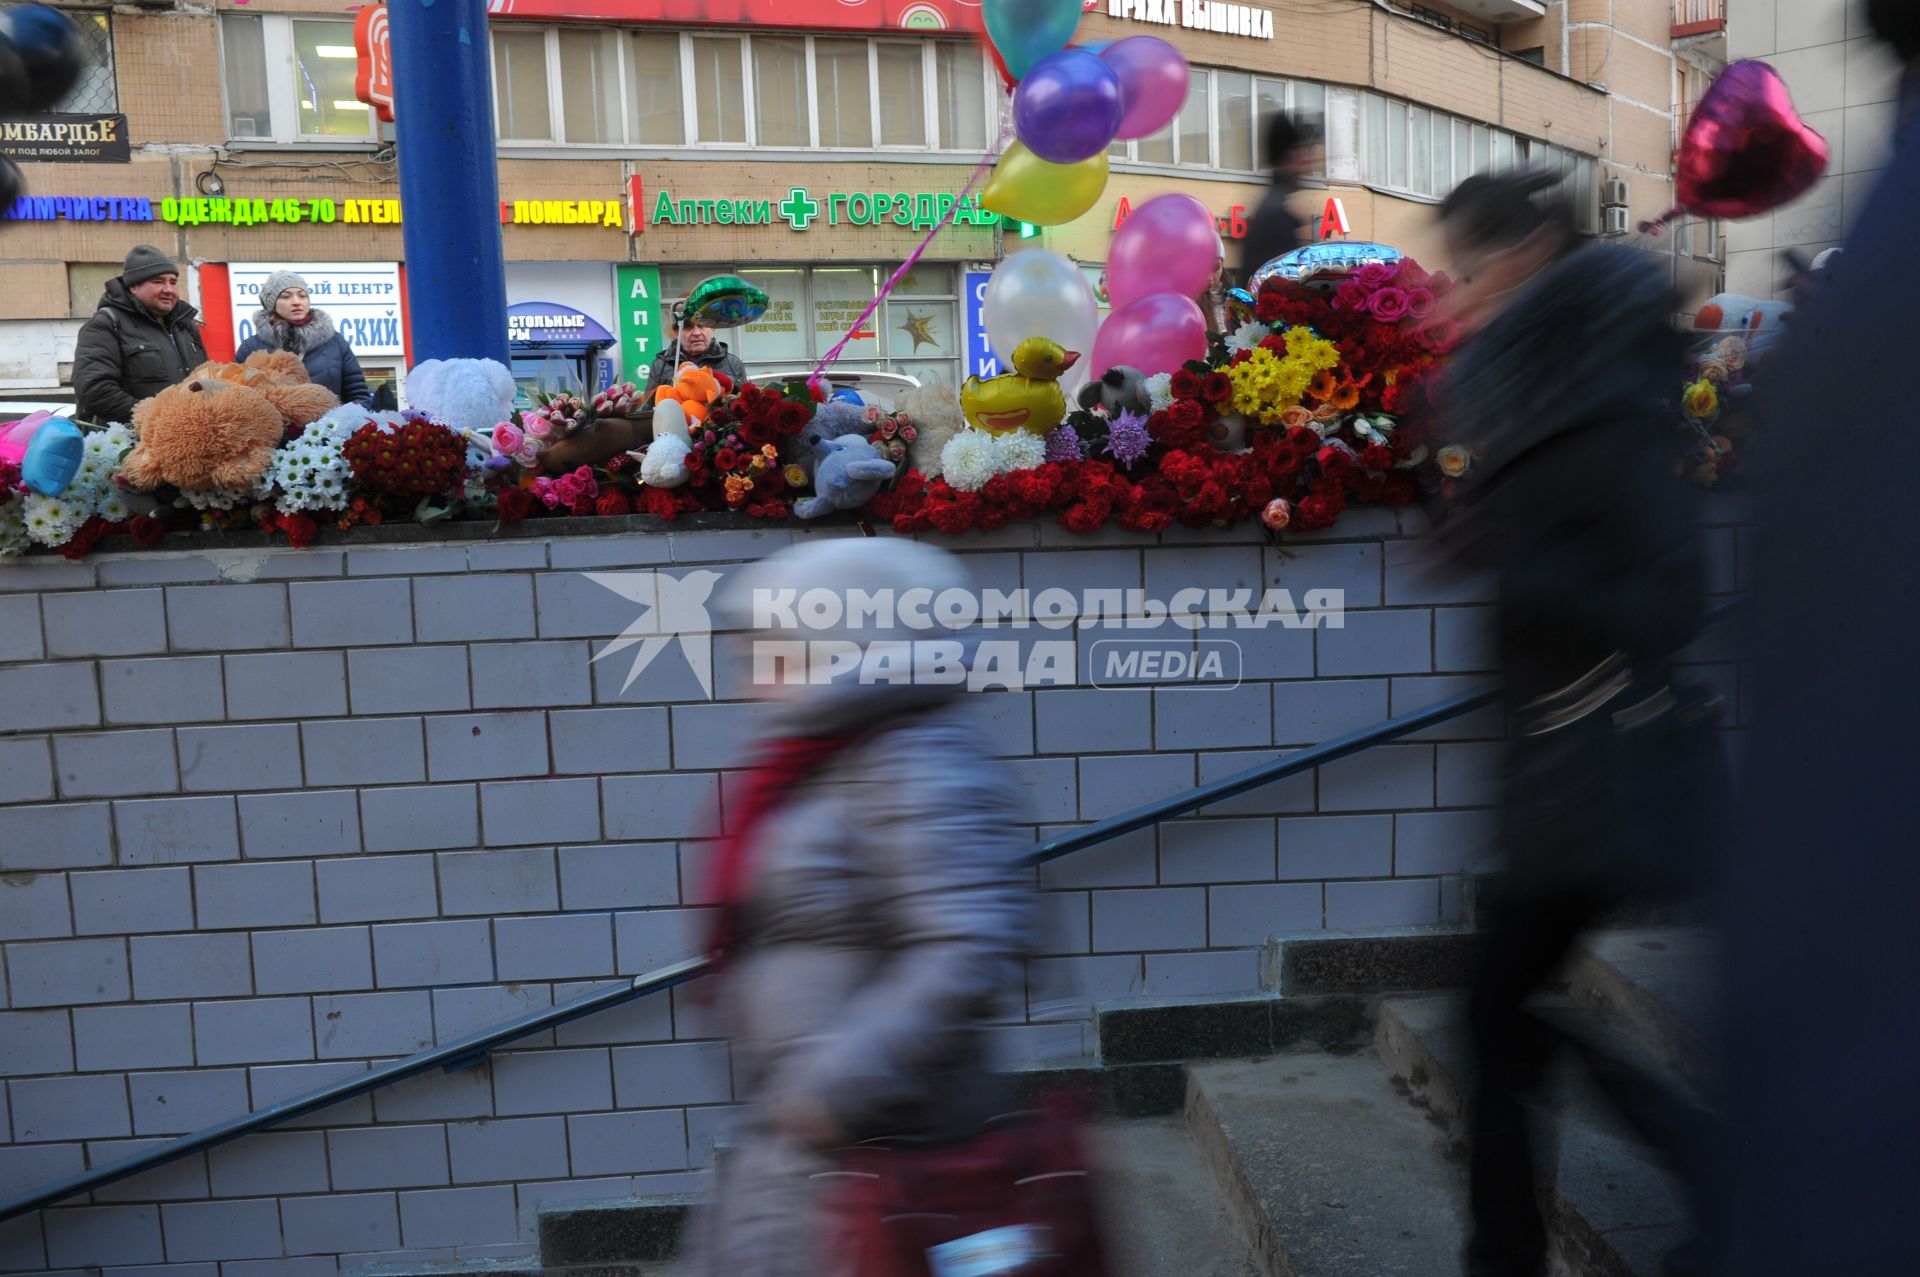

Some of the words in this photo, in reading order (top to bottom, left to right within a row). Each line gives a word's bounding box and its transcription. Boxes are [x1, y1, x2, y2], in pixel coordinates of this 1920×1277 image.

[1180, 0, 1274, 39] ВЫШИВКА
[0, 120, 116, 145] МБАРДЬЕ
[18, 148, 37, 156] ПОД
[40, 147, 71, 156] ЛЮБОЙ
[73, 148, 100, 156] ЗАЛОГ
[161, 197, 269, 226] ОДЕЖДА
[270, 198, 336, 224] 46-70
[344, 199, 403, 224] АТЕЛ
[513, 200, 623, 227] ЛОМБАРД
[652, 191, 771, 225] Аптеки
[828, 192, 999, 231] ГОРЗДРАВ
[339, 283, 394, 297] ЦЕНТР
[815, 301, 875, 310] НАСТОЛЬНЫ
[508, 315, 584, 328] СТОЛЬНЫЕ
[631, 279, 650, 380] Апте
[508, 328, 531, 341] РЫ
